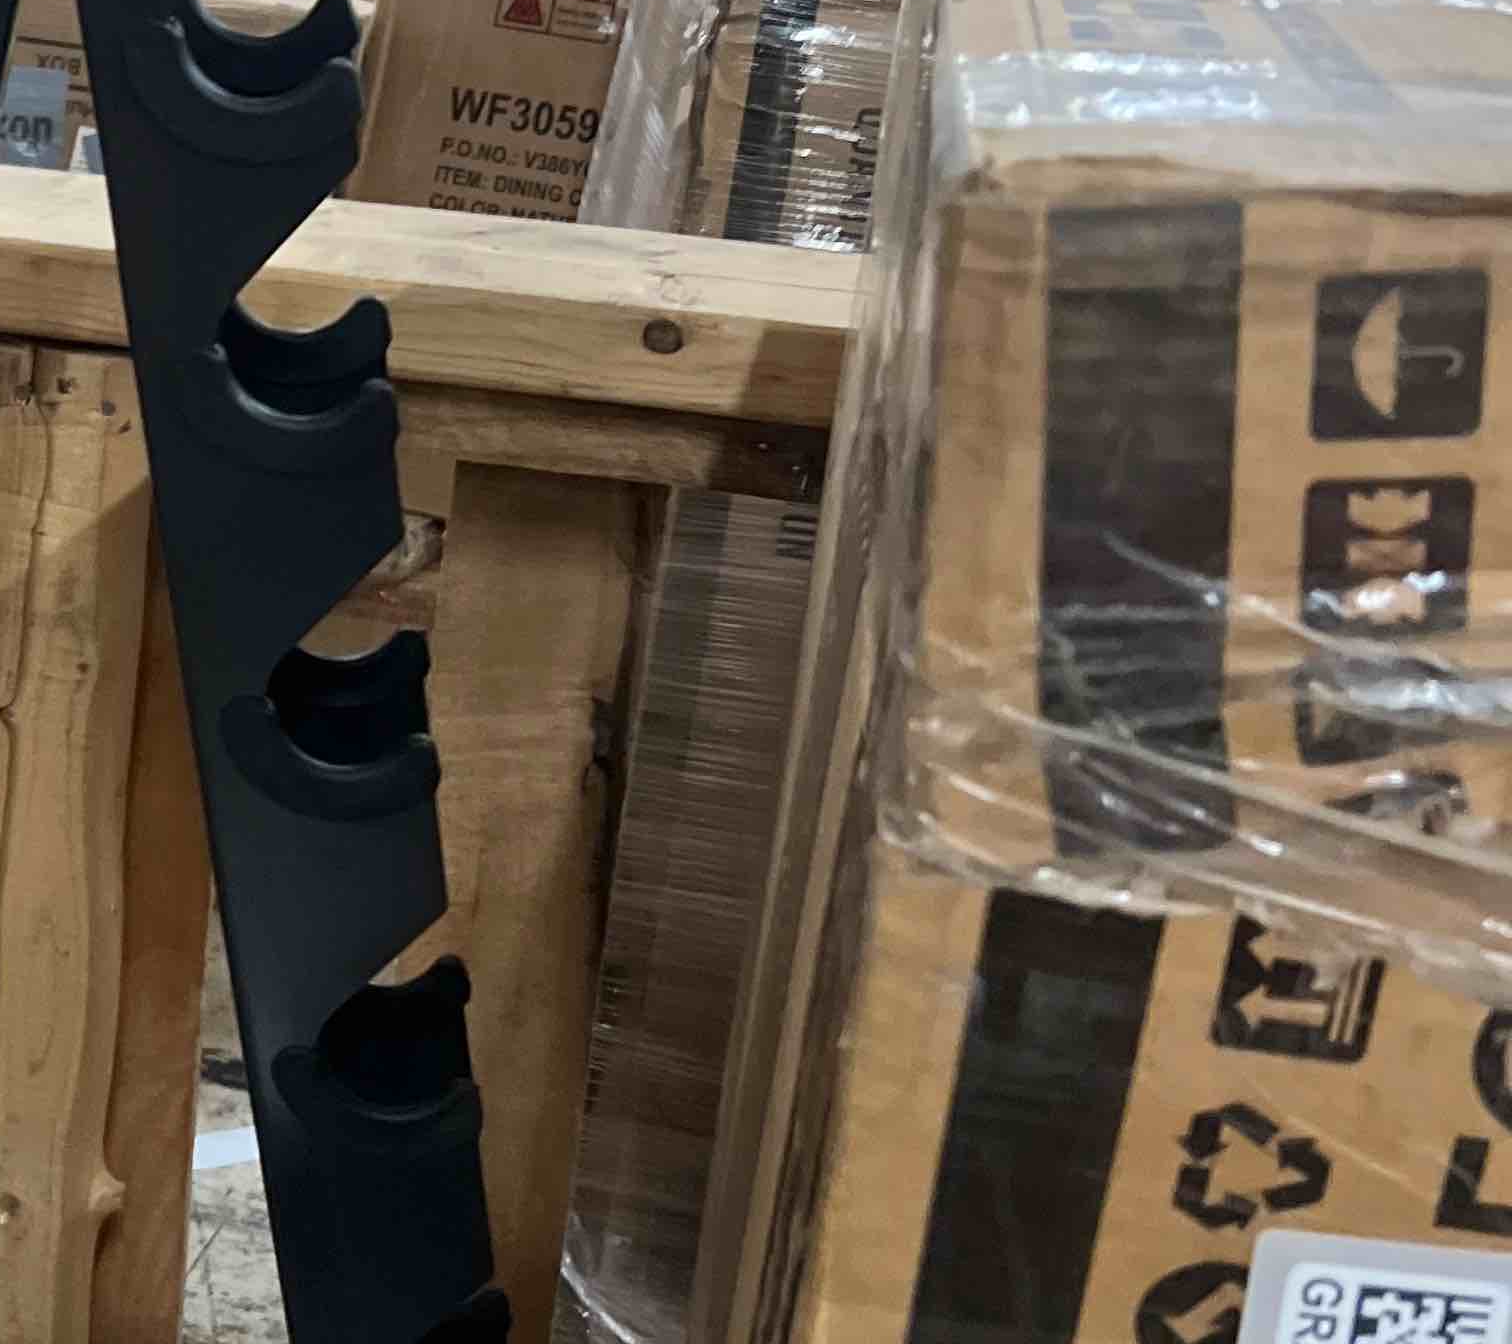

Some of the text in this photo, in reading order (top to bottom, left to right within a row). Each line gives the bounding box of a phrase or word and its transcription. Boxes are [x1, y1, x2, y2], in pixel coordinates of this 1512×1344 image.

[446, 85, 601, 144] WF3059
[433, 163, 489, 190] ITEM:
[492, 174, 563, 203] DINING
